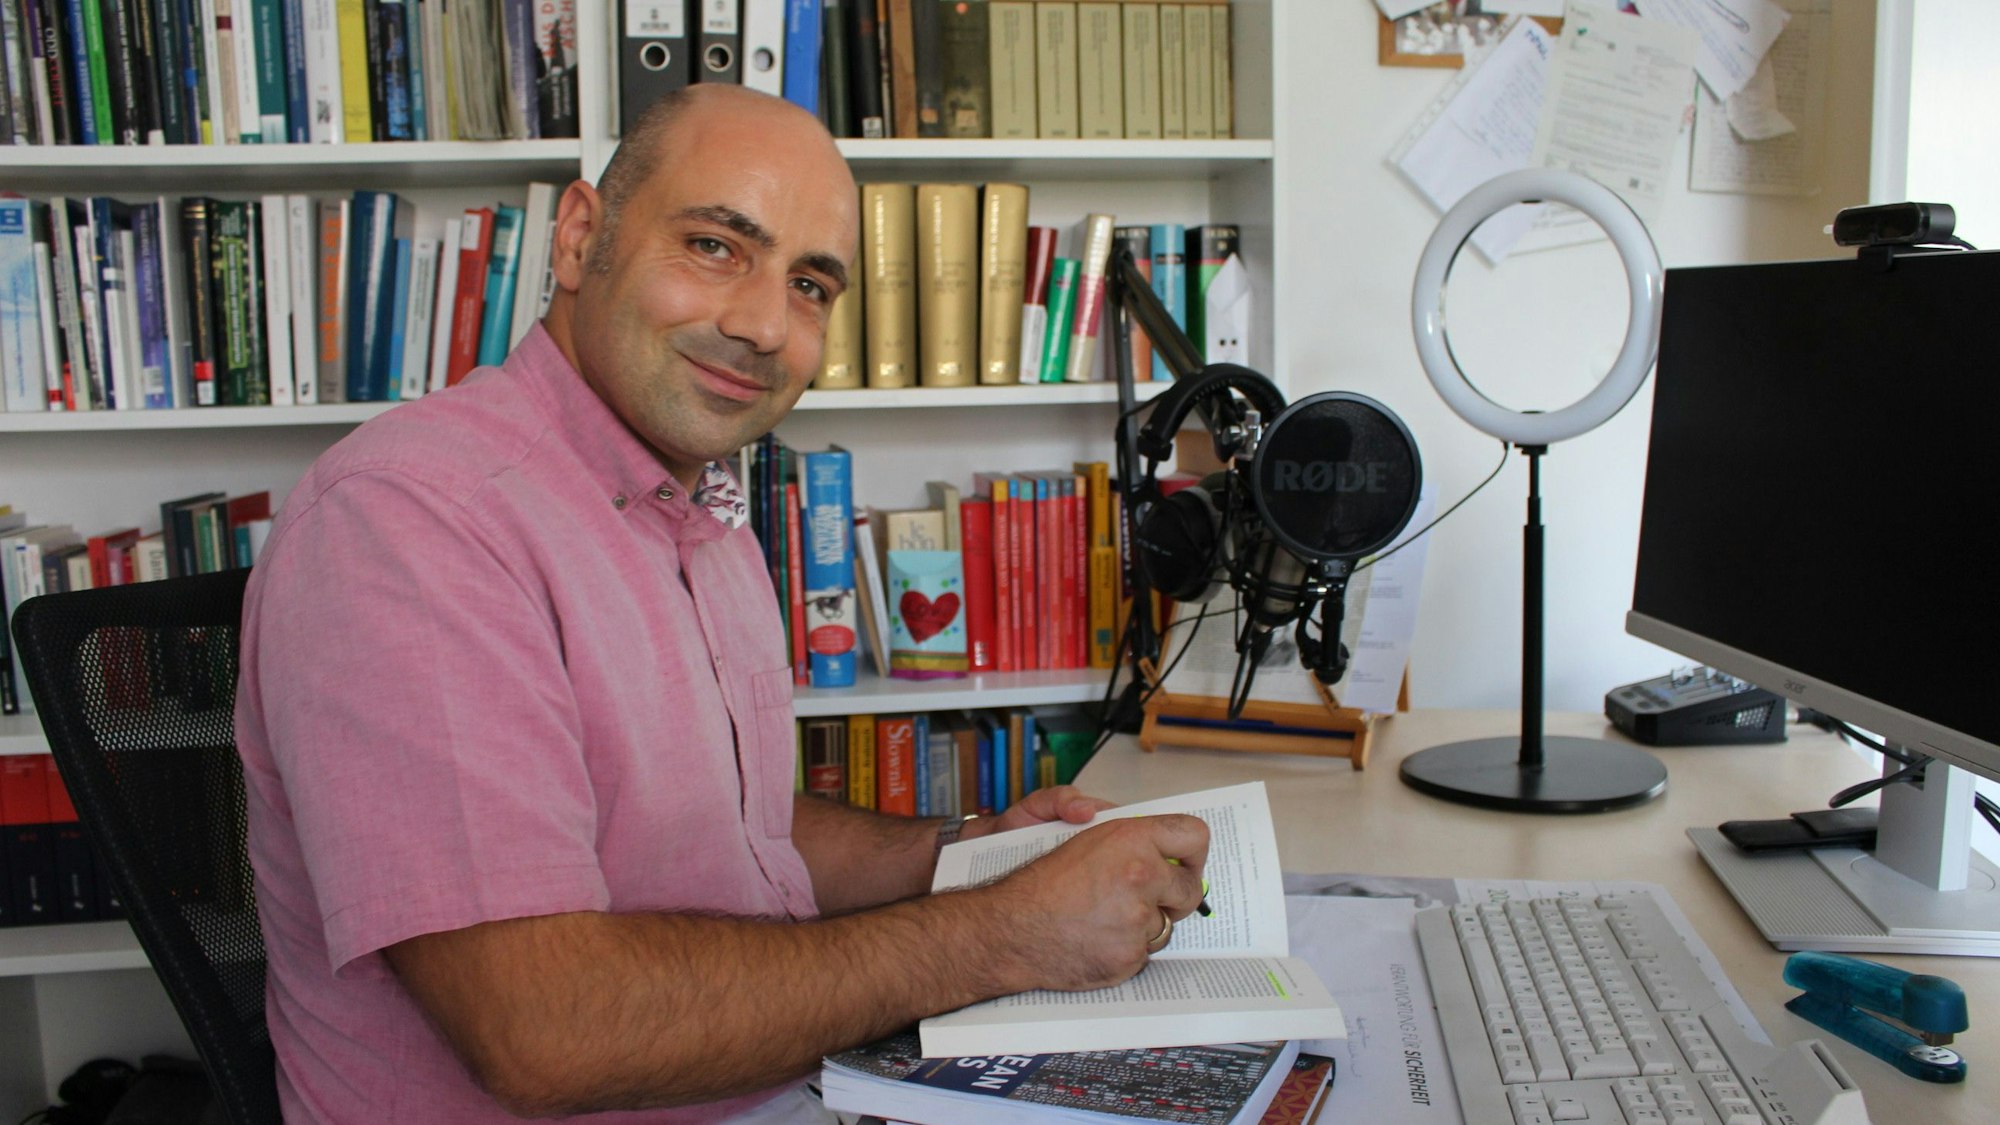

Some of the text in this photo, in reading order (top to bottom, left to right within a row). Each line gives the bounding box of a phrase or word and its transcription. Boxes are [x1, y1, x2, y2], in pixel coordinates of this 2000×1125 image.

[1273, 459, 1388, 493] RØDE
[1783, 678, 1809, 695] acer
[1389, 963, 1416, 1032] VERANTWORTUNG
[1404, 1050, 1431, 1106] SICHERHEIT
